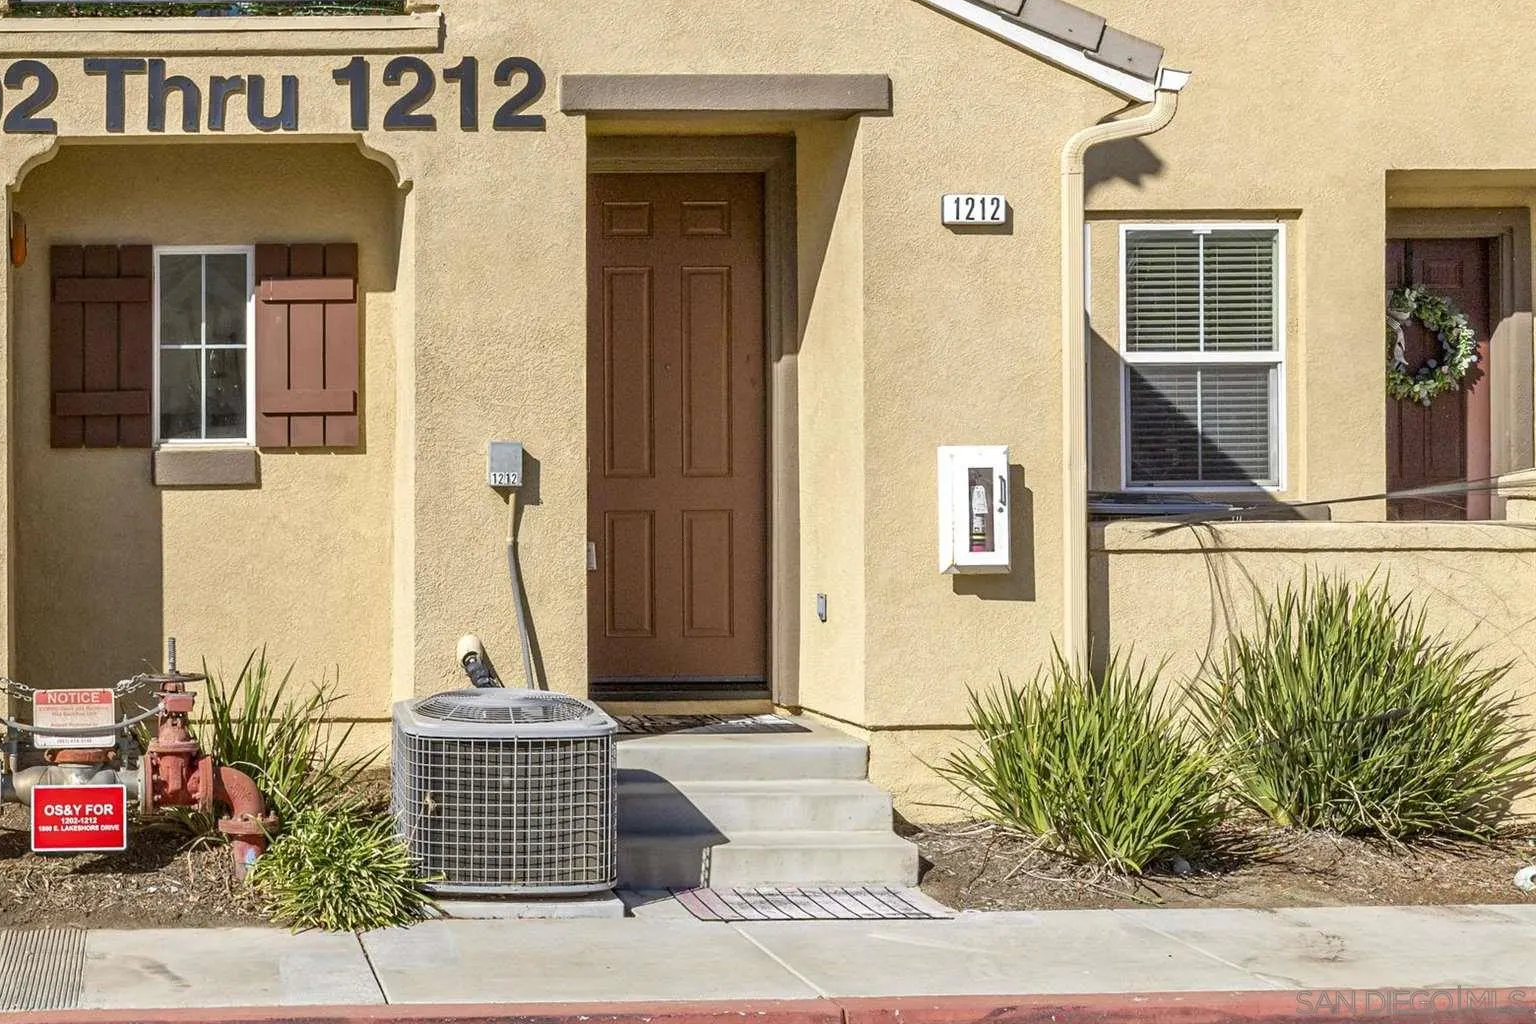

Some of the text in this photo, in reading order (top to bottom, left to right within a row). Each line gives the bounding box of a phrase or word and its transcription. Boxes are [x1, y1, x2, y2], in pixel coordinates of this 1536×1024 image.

[84, 58, 299, 133] Thru
[332, 56, 546, 132] 1212
[954, 197, 1001, 221] 1212
[492, 473, 517, 485] 1212
[47, 691, 101, 704] NOTICE
[44, 804, 114, 816] OS&Y FOR
[61, 817, 98, 825] 1202-1212
